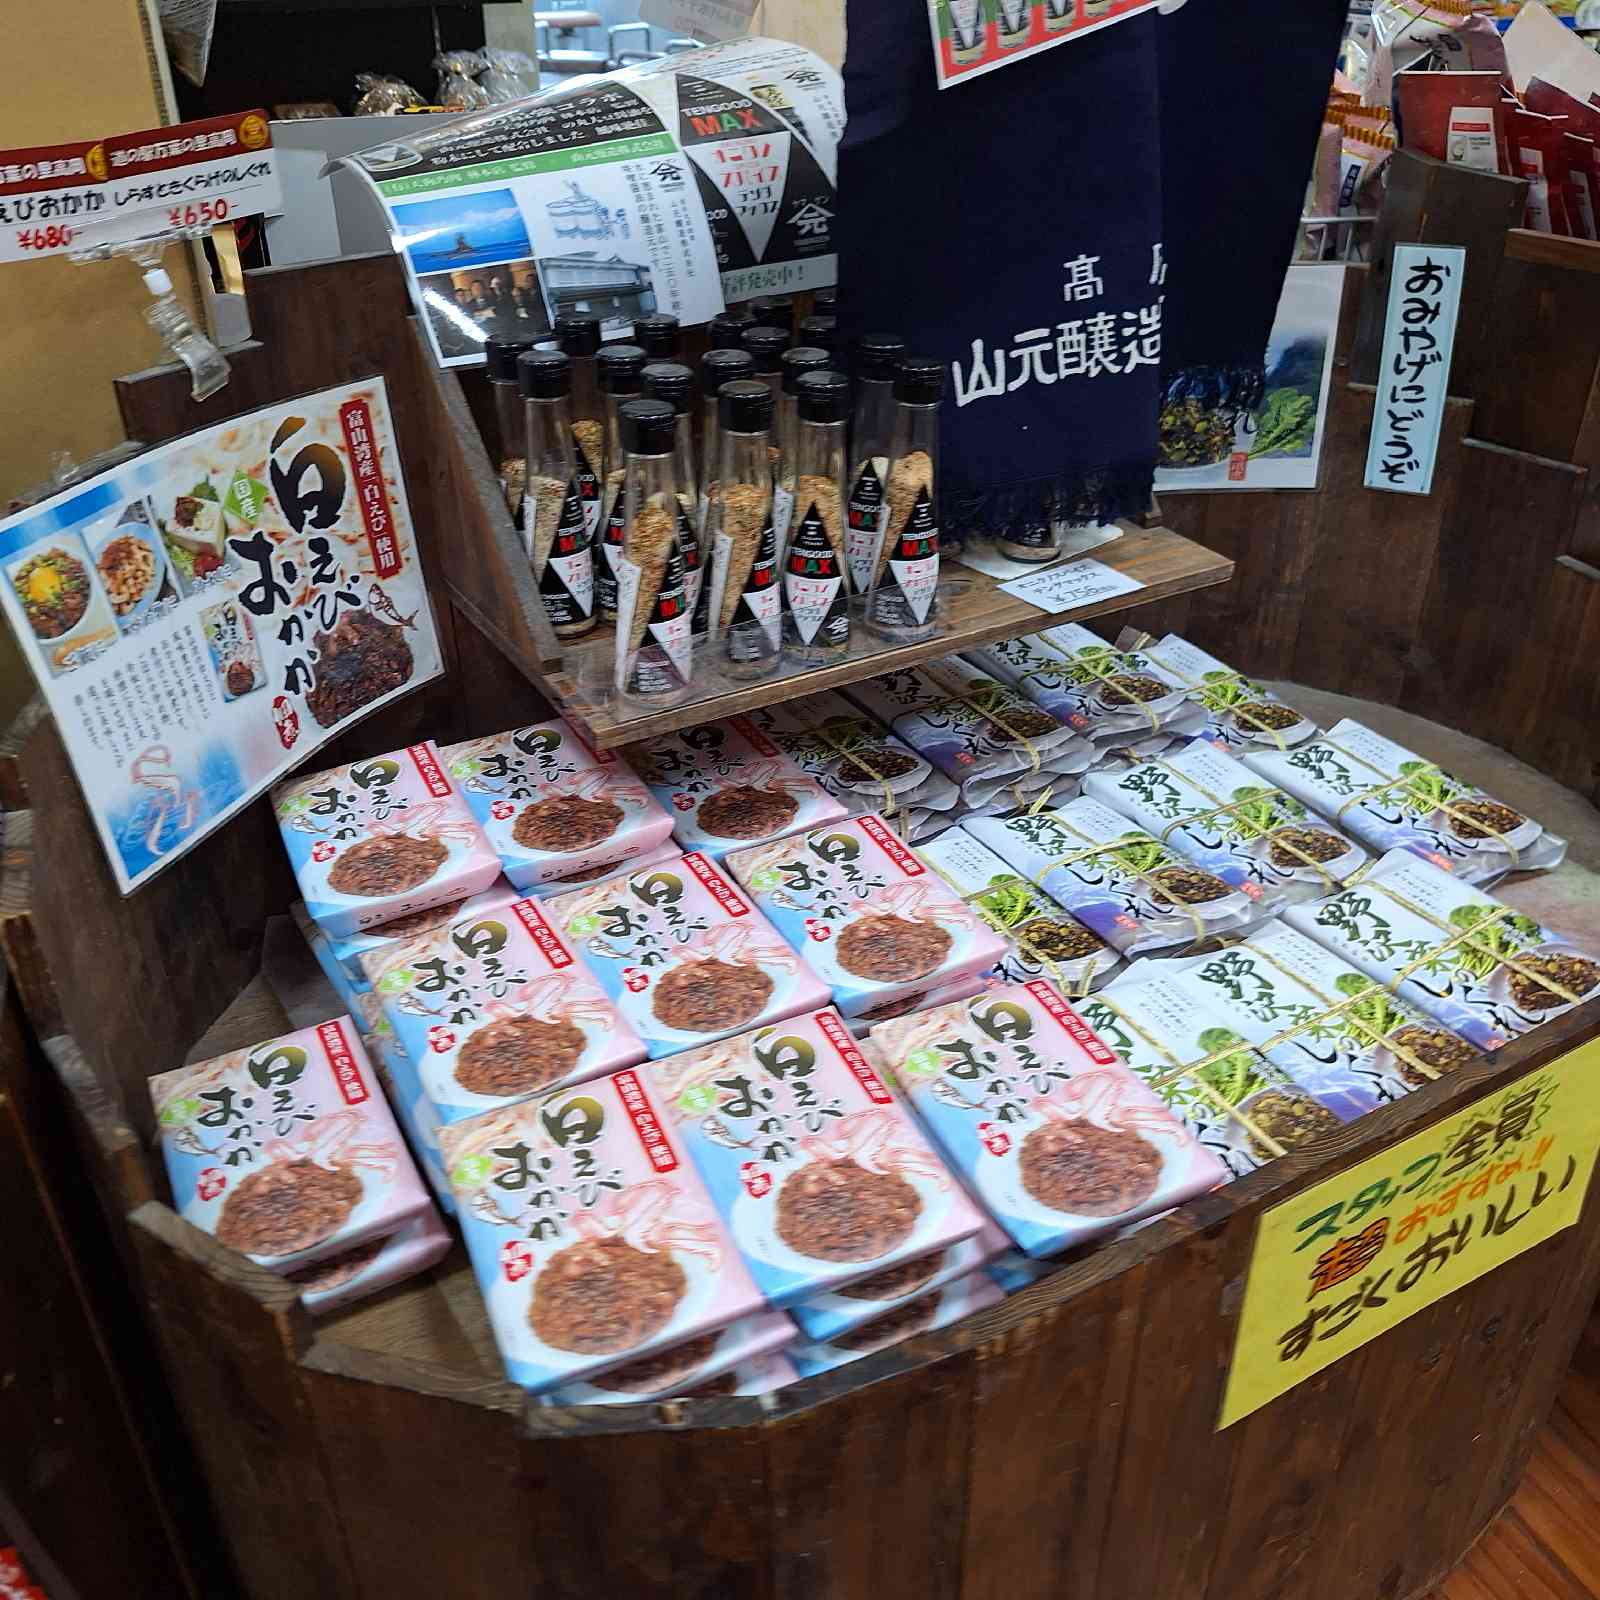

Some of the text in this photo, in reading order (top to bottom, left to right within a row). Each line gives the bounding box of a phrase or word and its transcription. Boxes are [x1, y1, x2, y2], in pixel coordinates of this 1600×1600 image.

[689, 109, 765, 137] MAX
[1380, 255, 1453, 484] おみやげにどうぞ
